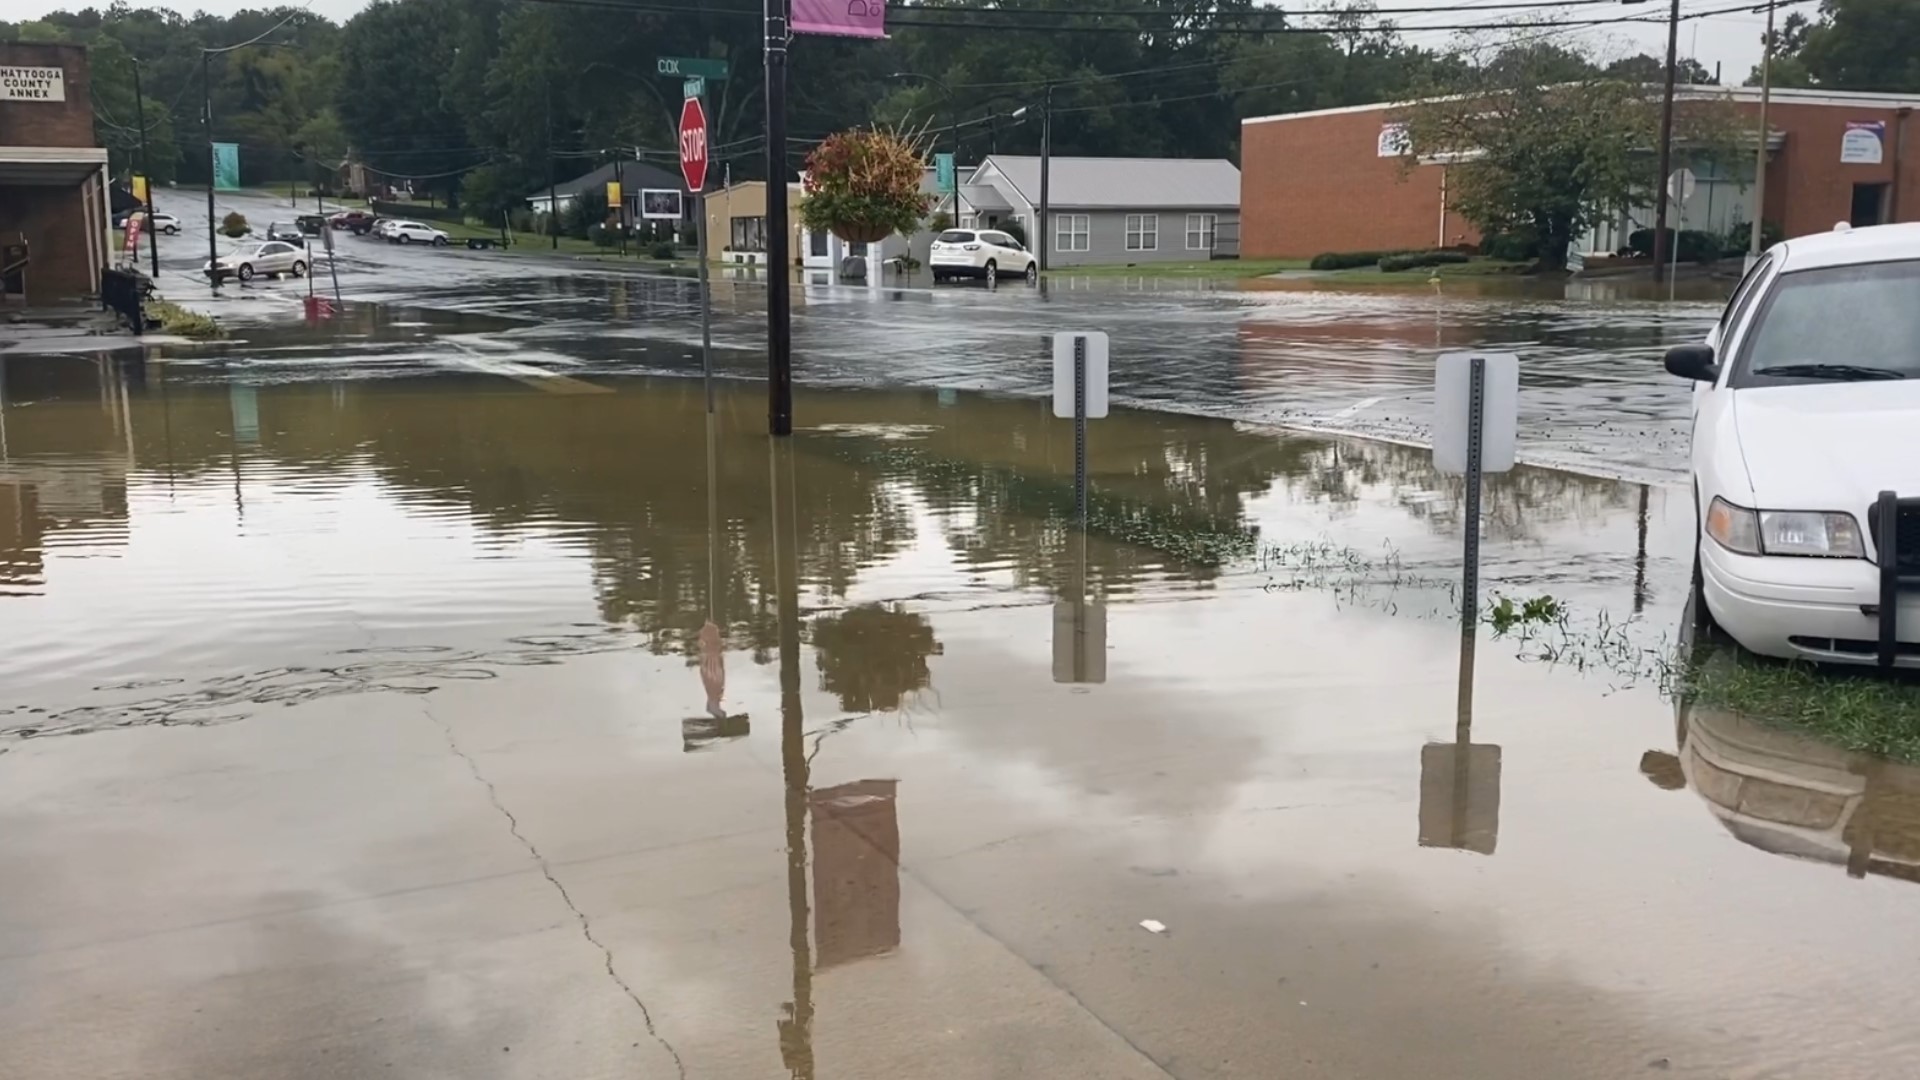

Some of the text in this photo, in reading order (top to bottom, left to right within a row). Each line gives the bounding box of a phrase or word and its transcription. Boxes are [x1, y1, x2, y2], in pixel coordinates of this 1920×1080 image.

[657, 59, 680, 74] COX
[1, 68, 62, 79] HATTOOGA
[3, 78, 52, 89] COUNTY
[9, 88, 48, 98] ANNEX
[682, 127, 704, 163] STOP
[126, 220, 138, 248] OPEN
